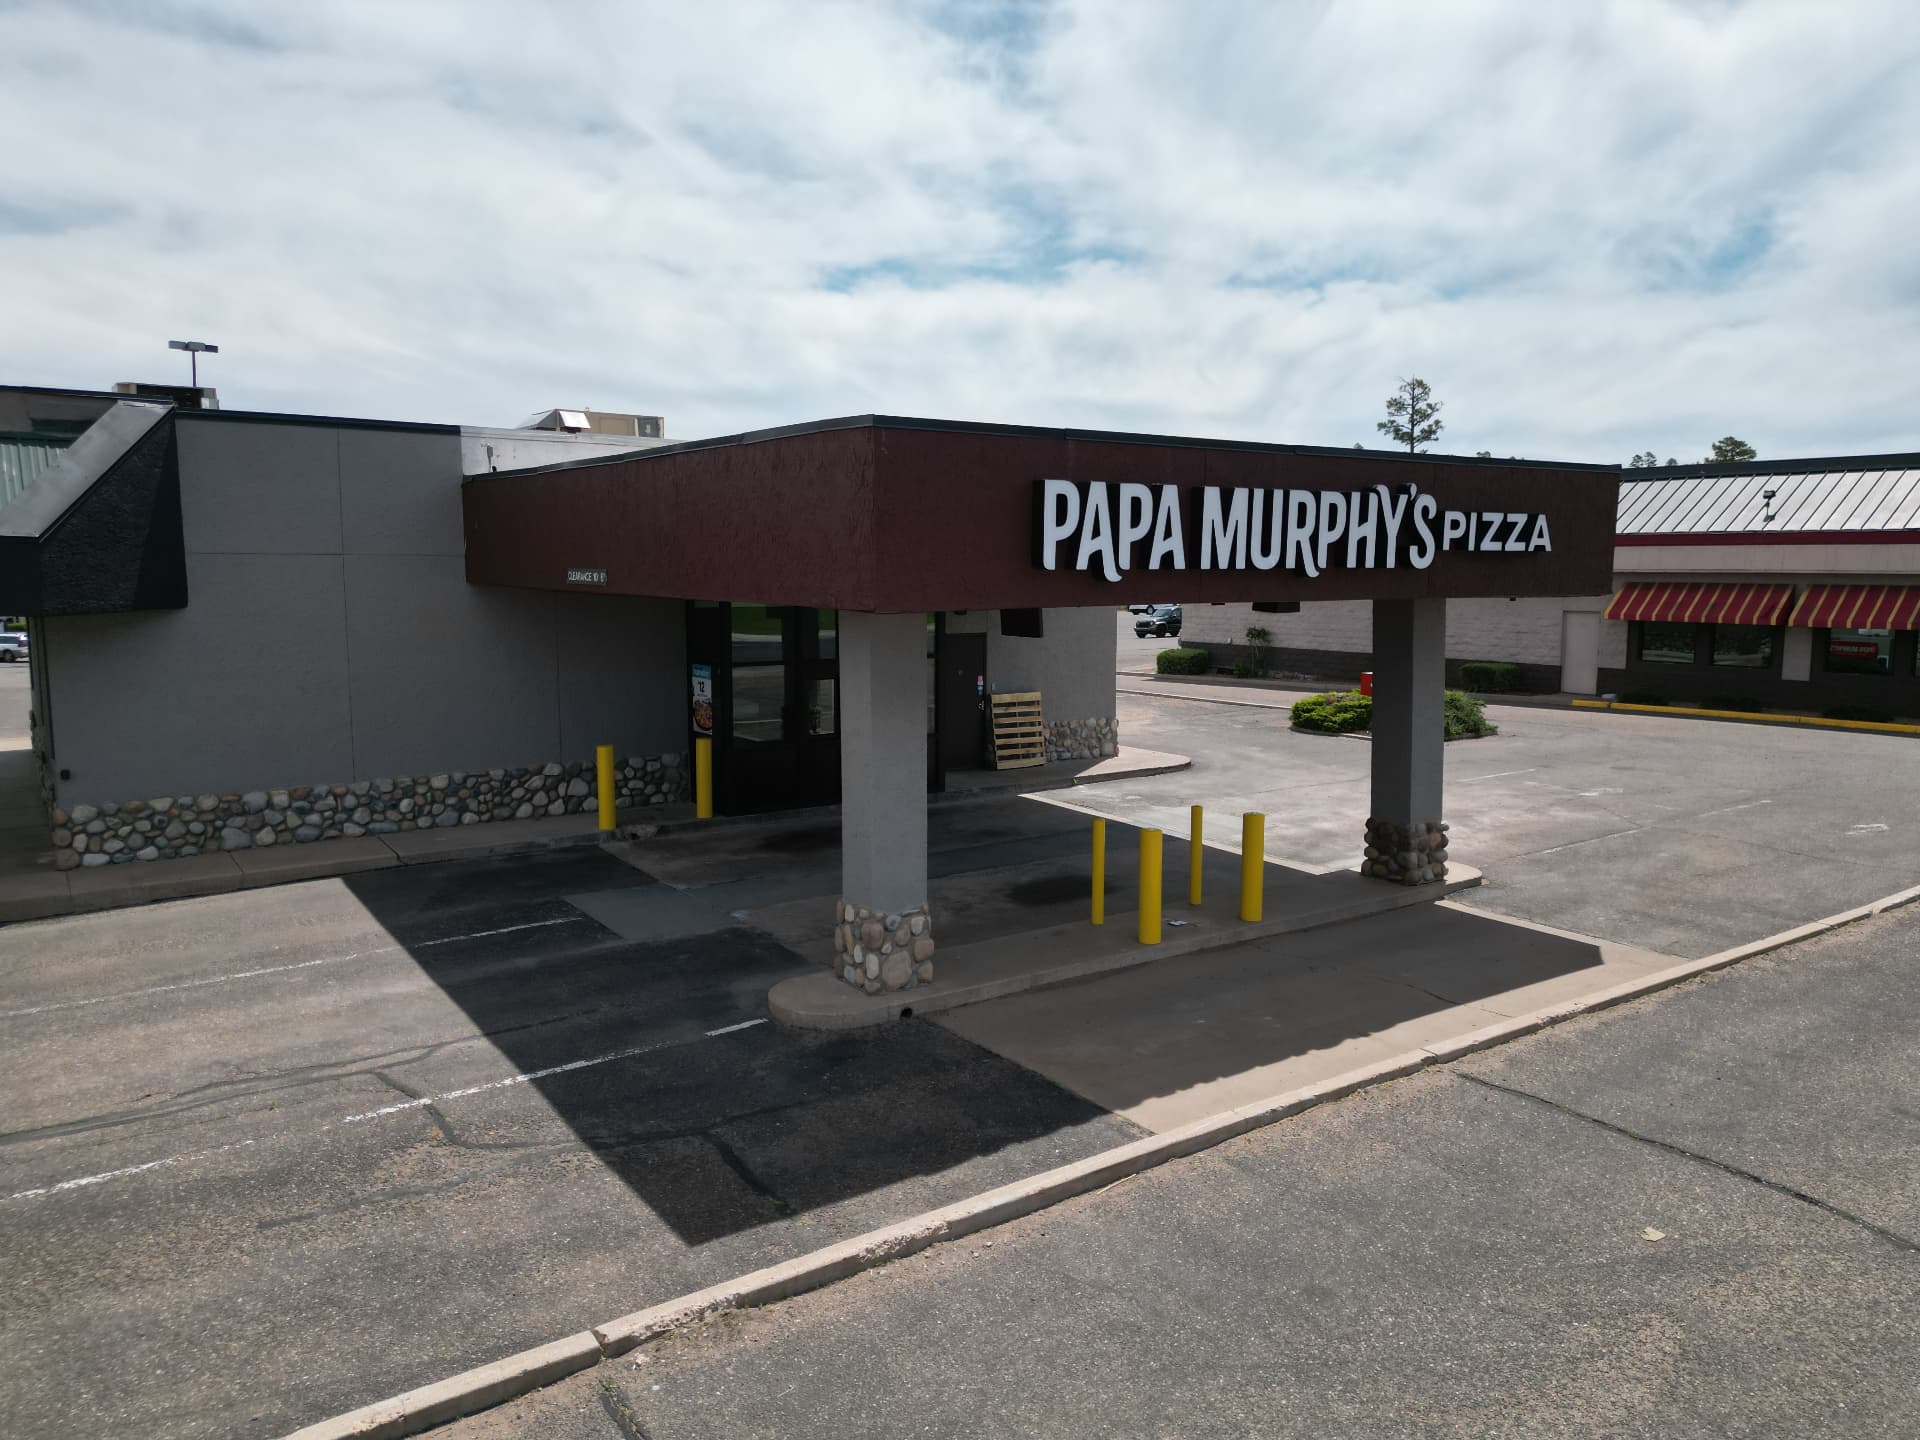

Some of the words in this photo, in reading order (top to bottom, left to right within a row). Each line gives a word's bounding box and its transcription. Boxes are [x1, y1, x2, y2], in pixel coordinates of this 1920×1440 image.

[1043, 479, 1186, 582] PAPA
[1200, 483, 1437, 578] MURPHY'S
[1442, 511, 1552, 552] PIZZA
[567, 571, 592, 582] CLEARANCE
